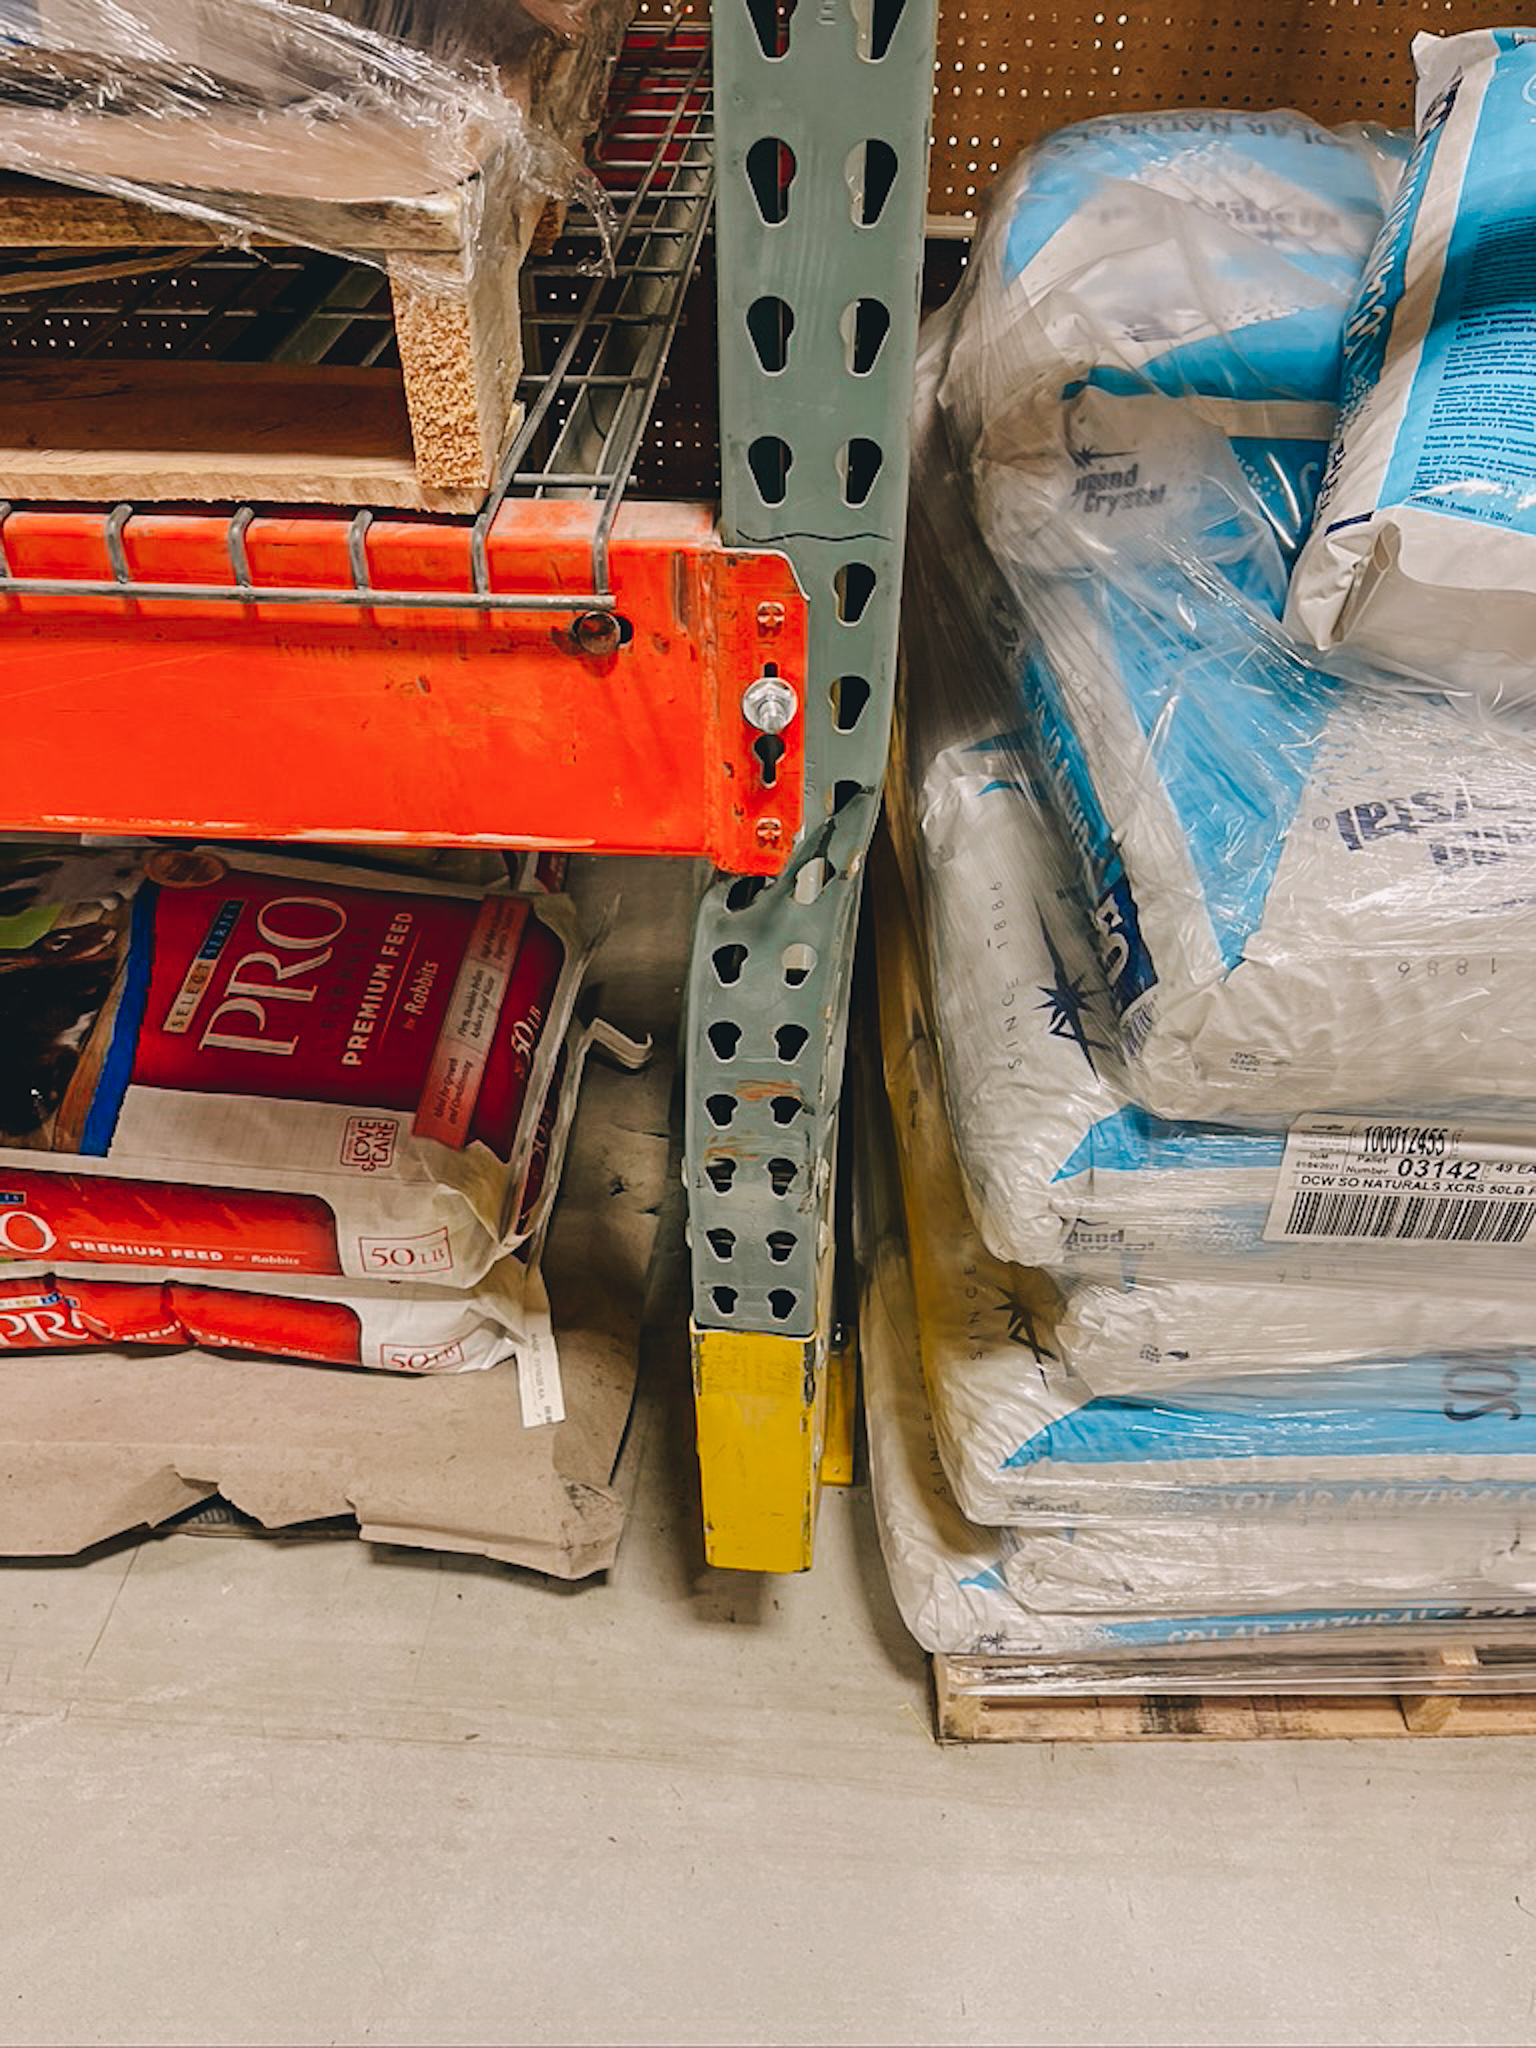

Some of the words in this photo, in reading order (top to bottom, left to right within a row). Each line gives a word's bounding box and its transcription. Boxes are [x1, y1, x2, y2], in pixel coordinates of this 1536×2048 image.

[990, 881, 1009, 950] 1886
[198, 895, 348, 1056] PRO
[341, 965, 395, 1067] PREMIUM
[381, 911, 415, 957] FEED
[403, 959, 440, 1016] Rabbits
[509, 1020, 534, 1056] 50
[1001, 977, 1024, 1070] SINCE
[352, 1119, 376, 1162] LOVE
[372, 1121, 395, 1162] CARE
[1364, 1125, 1450, 1157] 100012455
[1346, 1166, 1390, 1175] Number
[1397, 1158, 1480, 1181] 03142
[1357, 1154, 1389, 1164] Pallet
[1495, 1163, 1514, 1174] 49
[1301, 1175, 1334, 1187] DCW
[1338, 1176, 1359, 1187] SO
[1362, 1178, 1441, 1192] NATURALS
[1443, 1181, 1485, 1194] XCRS
[69, 1240, 165, 1259] PREMIUM
[171, 1247, 224, 1262] FEED
[251, 1253, 301, 1266] Rabbits
[370, 1245, 417, 1269] 50
[419, 1248, 446, 1267] LB
